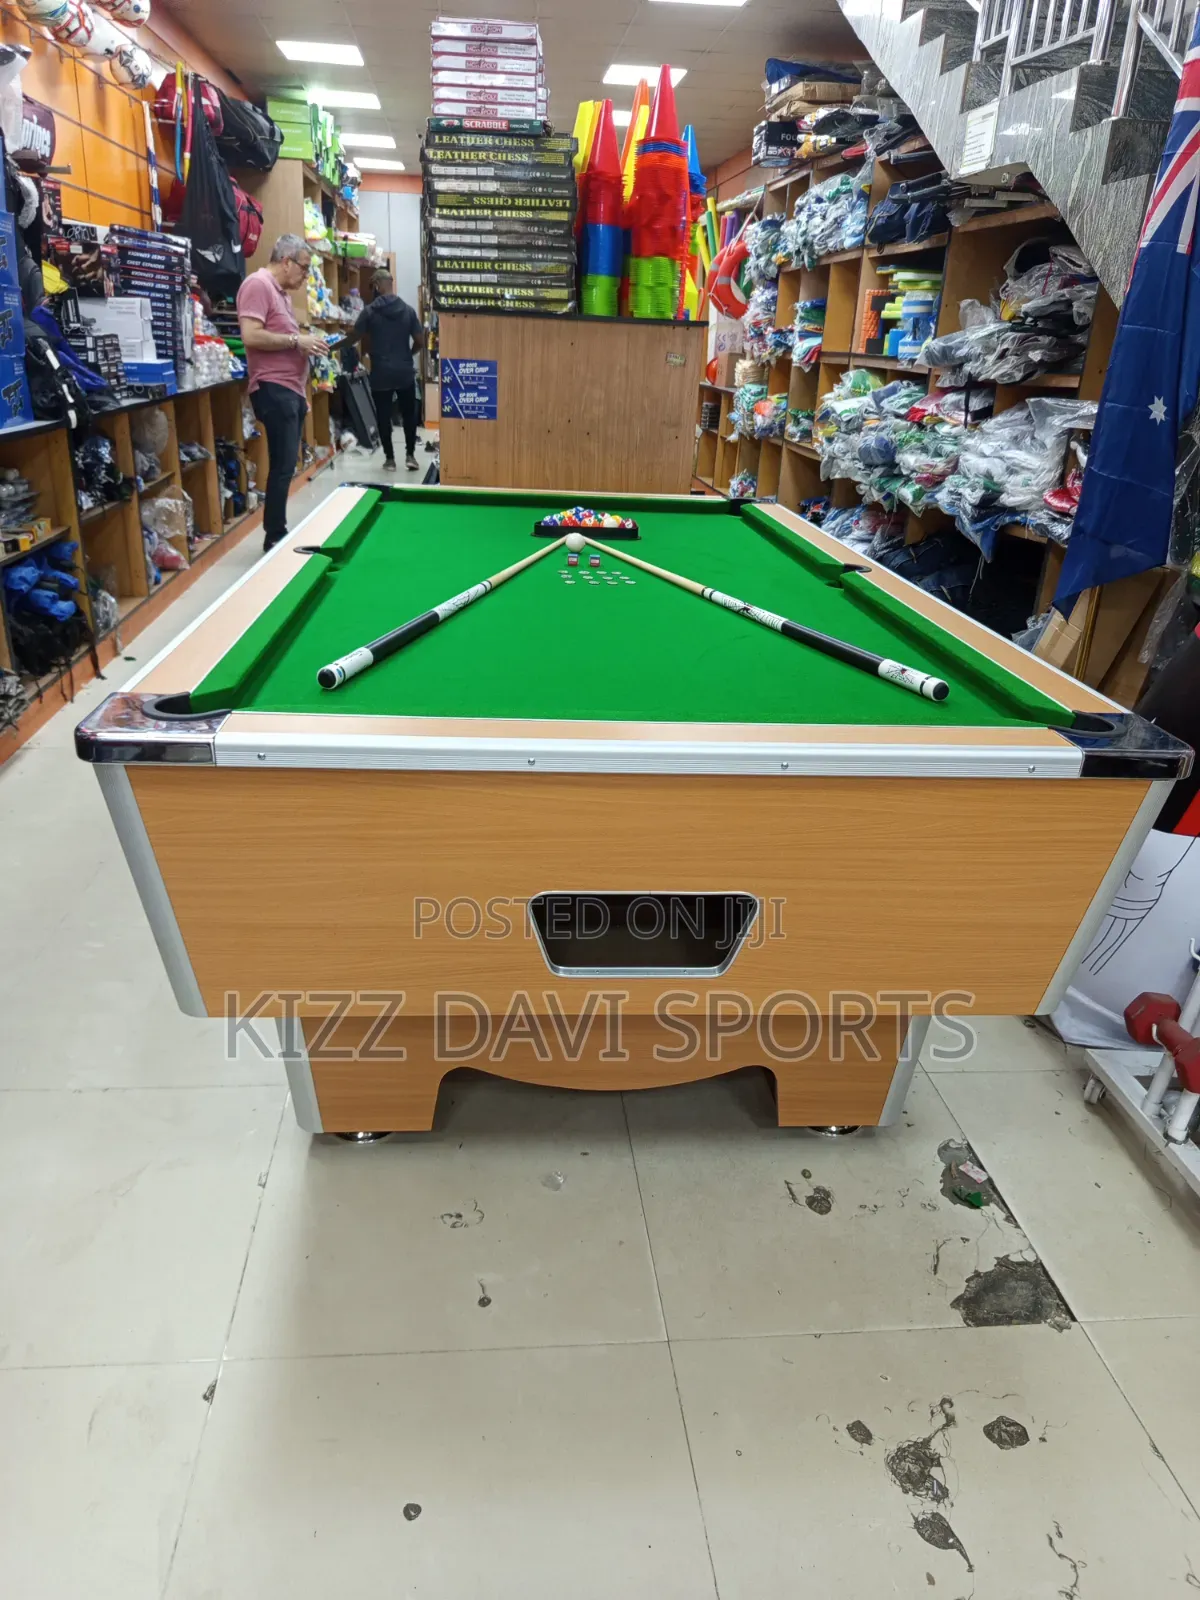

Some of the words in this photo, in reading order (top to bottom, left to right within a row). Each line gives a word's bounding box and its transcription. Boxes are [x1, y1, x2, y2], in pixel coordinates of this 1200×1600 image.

[464, 120, 509, 130] SCRABBLE
[434, 135, 493, 145] LEATHER
[495, 137, 535, 147] CHESS
[428, 150, 487, 160] LEATHER
[489, 152, 529, 161] CHESS
[473, 197, 512, 205] CHESS
[514, 197, 570, 207] LEATHER
[435, 208, 492, 217] LEATHER
[494, 210, 533, 218] CHESS
[436, 260, 492, 270] LEATHER
[494, 262, 532, 271] CHESS
[439, 284, 494, 294] LEATHER
[496, 287, 534, 297] CHESS
[440, 296, 495, 306] LEATHER
[497, 300, 535, 308] CHESS
